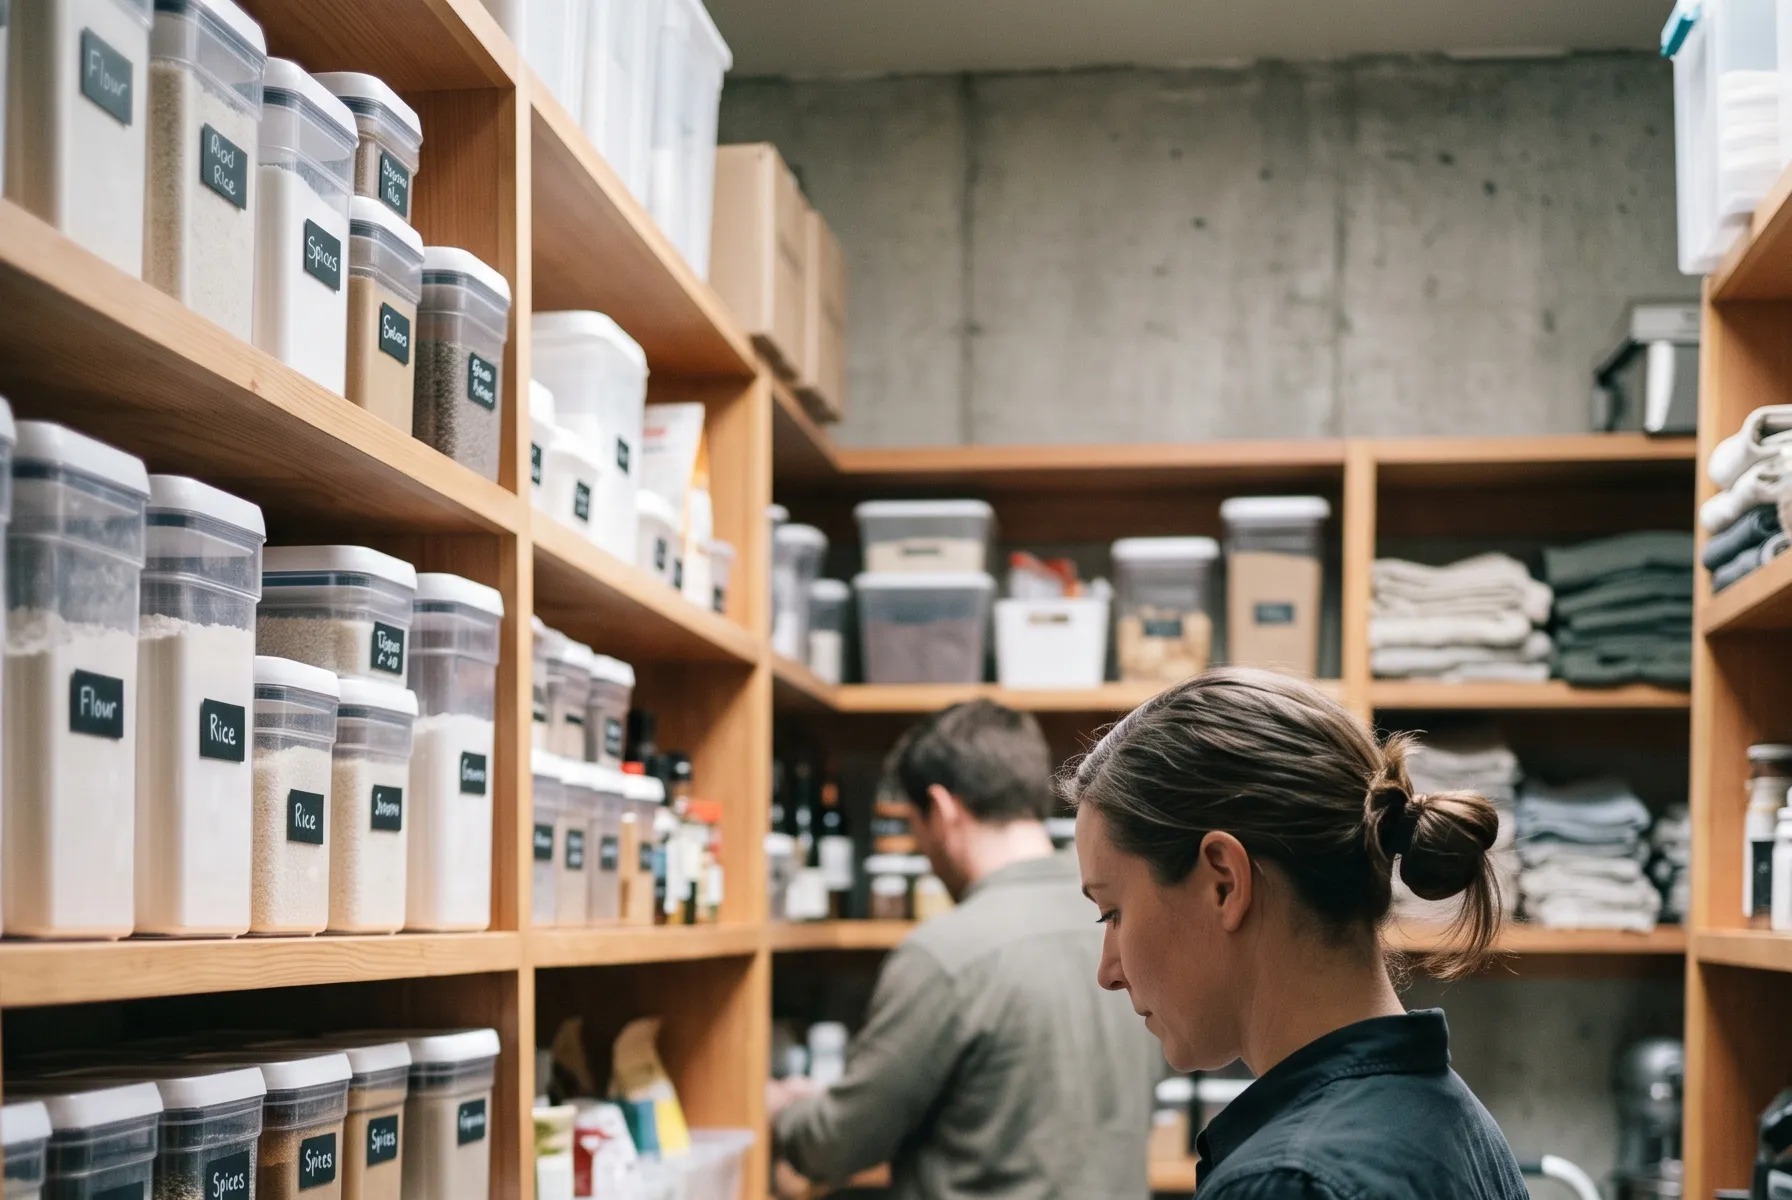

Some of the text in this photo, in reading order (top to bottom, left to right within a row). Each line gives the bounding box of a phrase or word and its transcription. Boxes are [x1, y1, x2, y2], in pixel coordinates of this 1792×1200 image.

[89, 49, 127, 97] Flour
[81, 686, 117, 719] Flour
[211, 714, 237, 745] Rice
[295, 803, 316, 830] Rice
